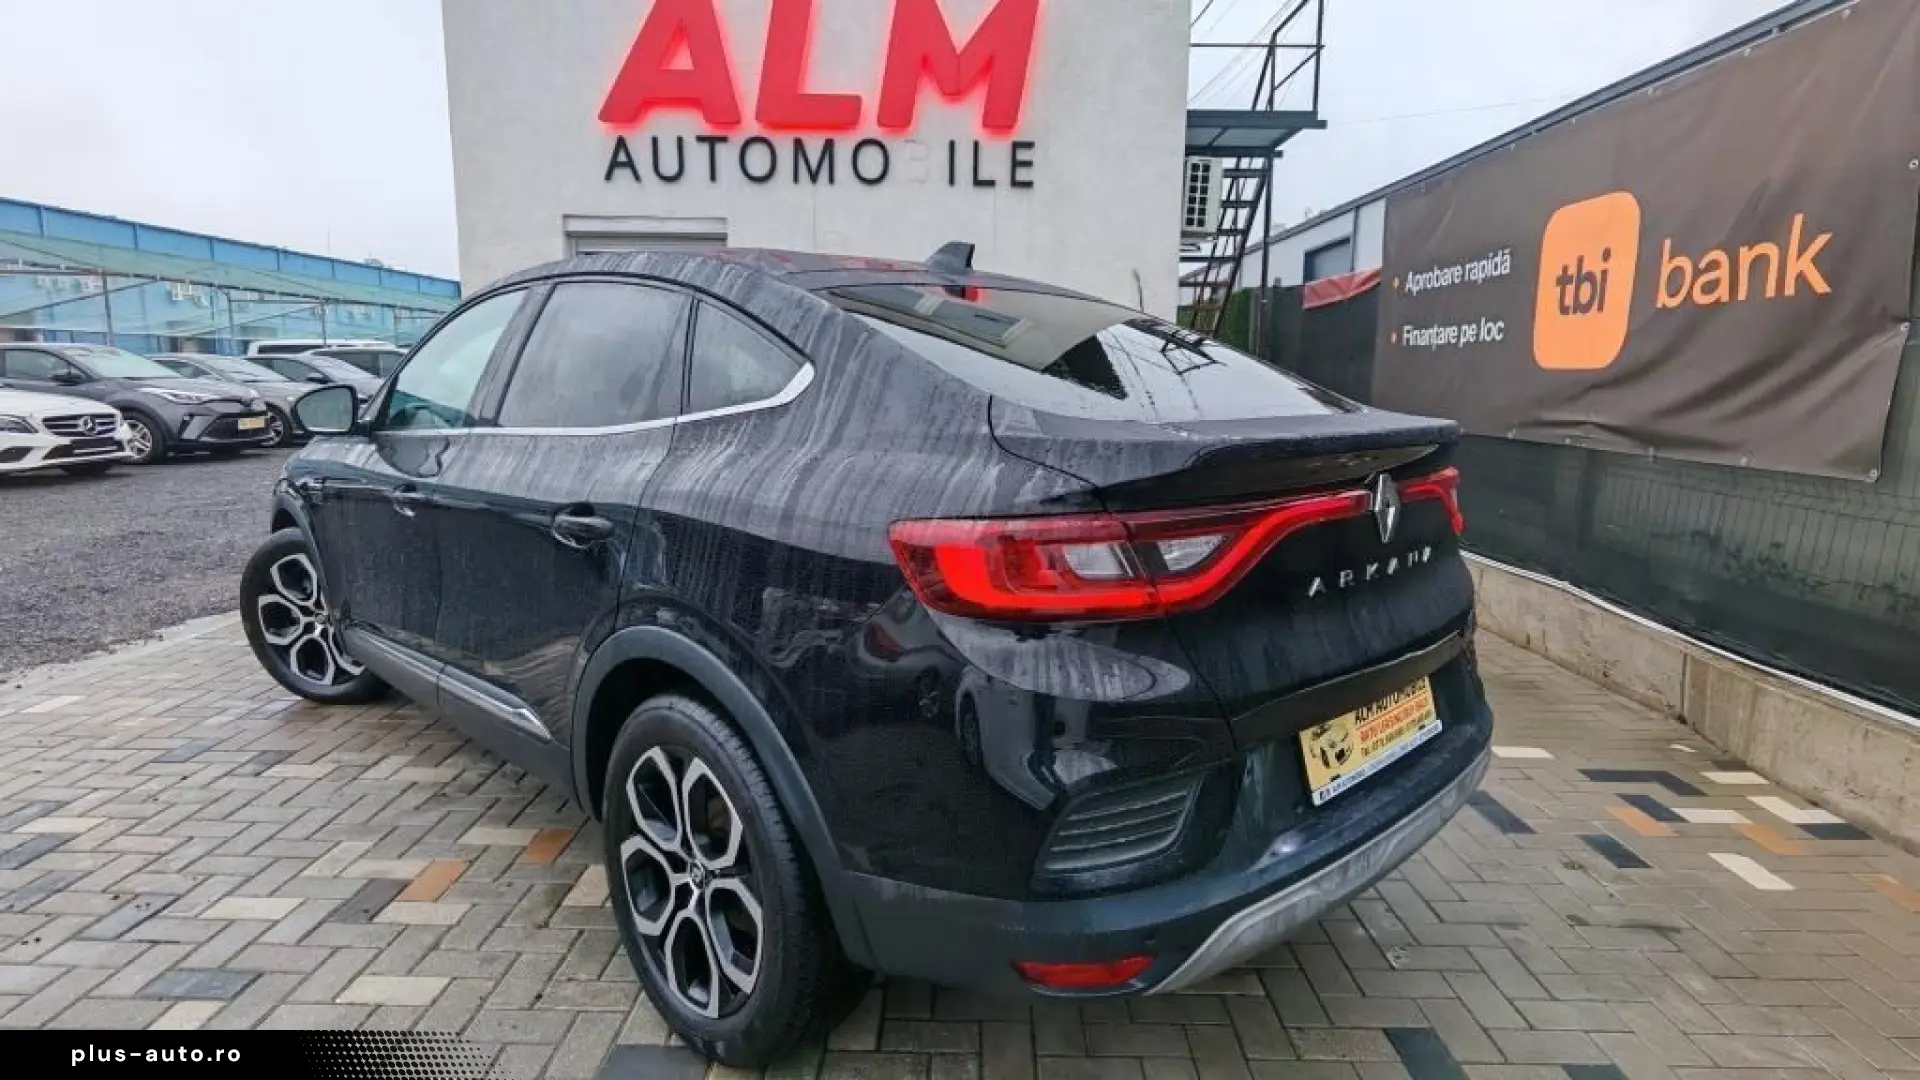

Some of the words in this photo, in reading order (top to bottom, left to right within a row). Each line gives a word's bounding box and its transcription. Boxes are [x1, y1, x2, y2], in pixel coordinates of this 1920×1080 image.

[597, 0, 1039, 130] ALM
[603, 134, 1036, 189] AUTOMOILE
[1404, 264, 1463, 297] Aprobare
[1464, 247, 1511, 285] rapidă
[1555, 246, 1612, 316] tbi
[1656, 211, 1833, 309] bank
[1403, 323, 1458, 352] Finanțare
[1459, 323, 1477, 348] pe
[1479, 316, 1505, 342] loc
